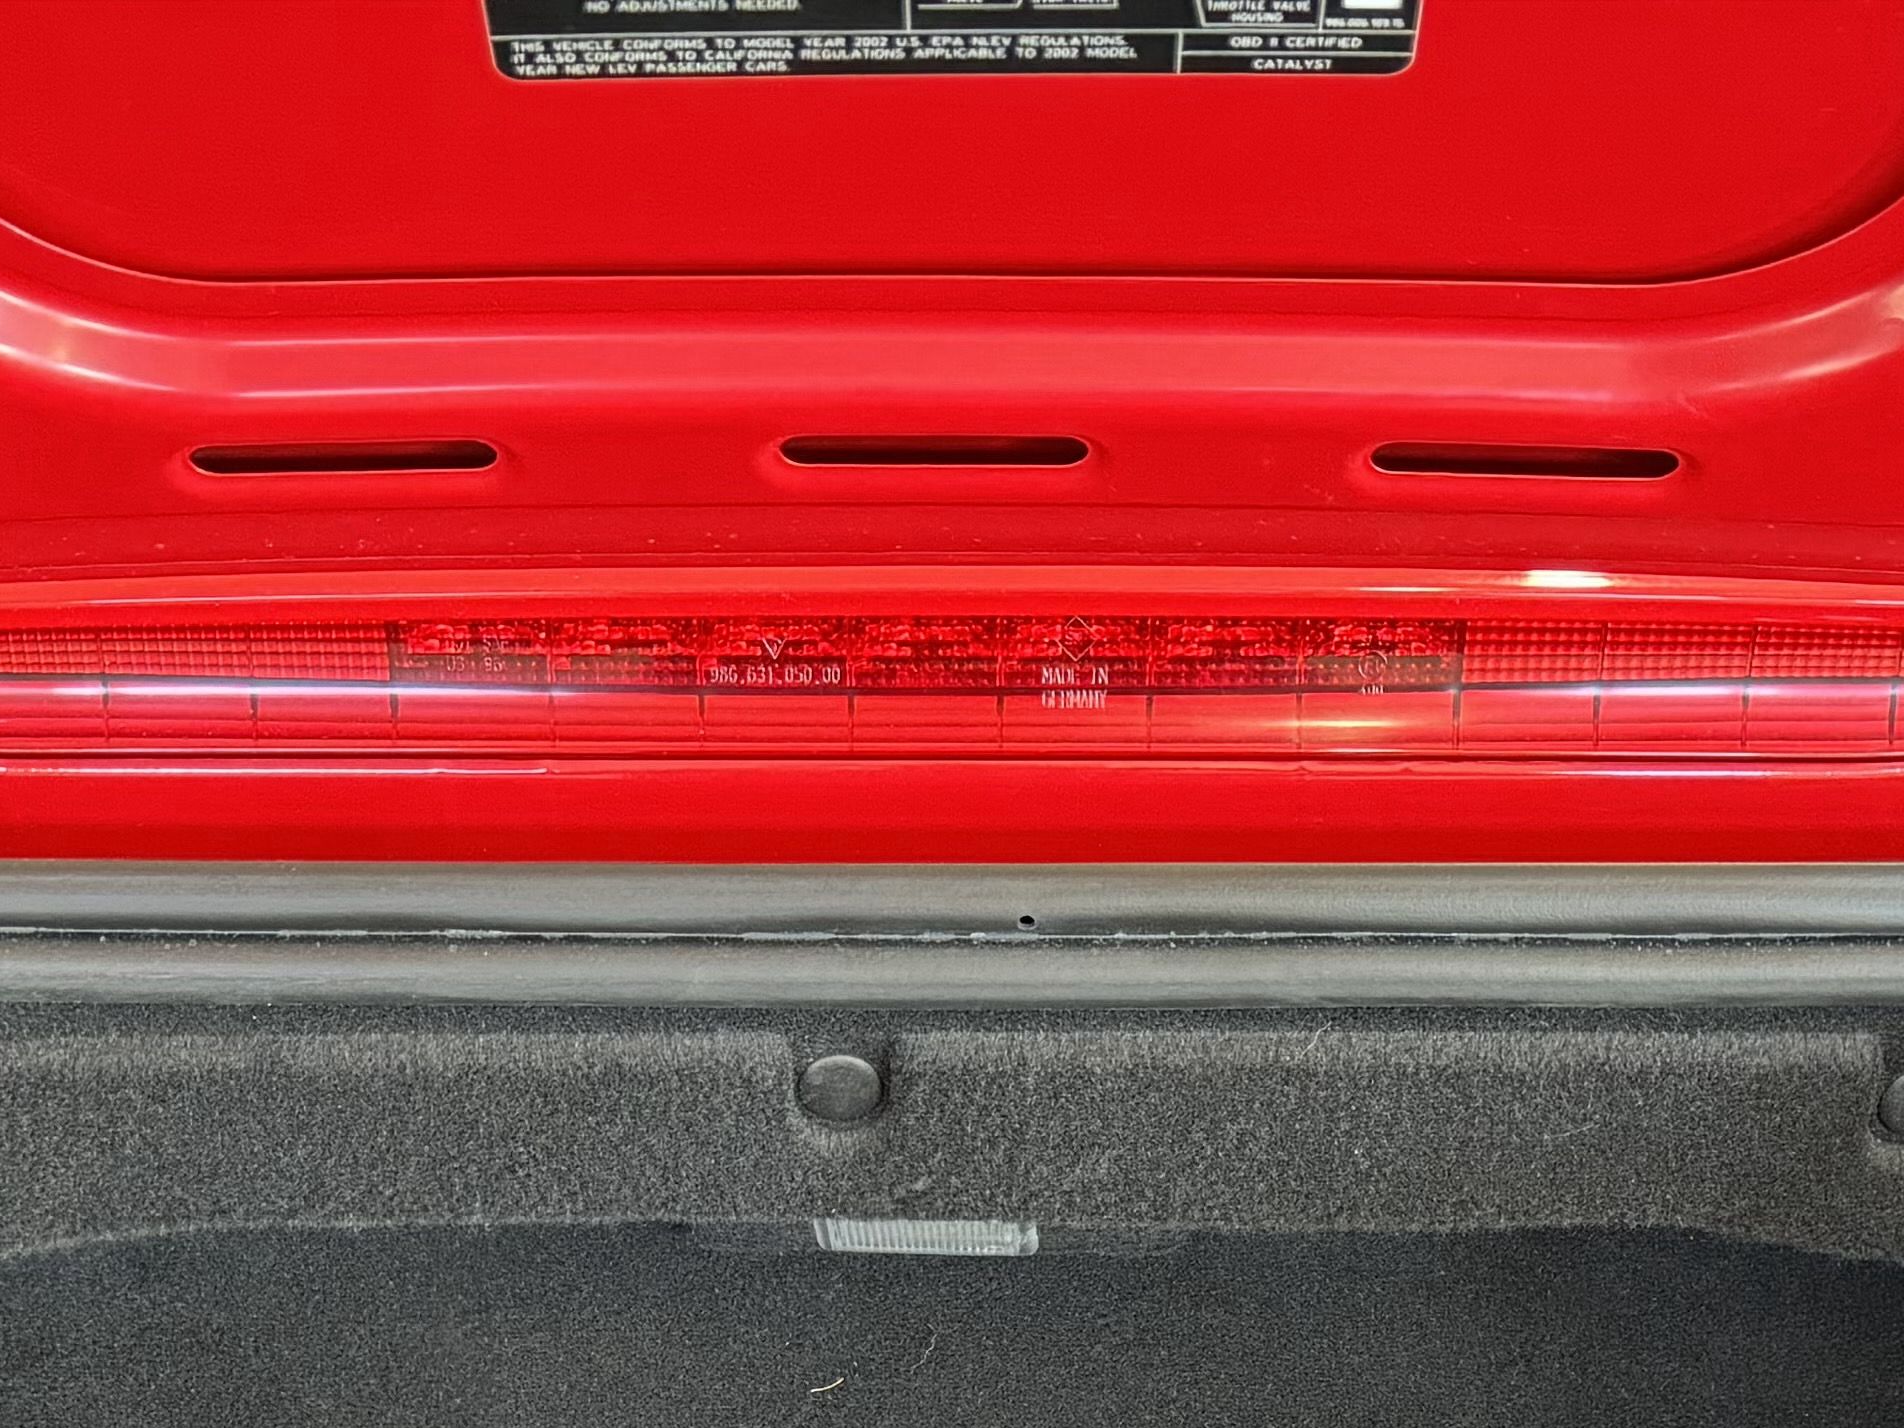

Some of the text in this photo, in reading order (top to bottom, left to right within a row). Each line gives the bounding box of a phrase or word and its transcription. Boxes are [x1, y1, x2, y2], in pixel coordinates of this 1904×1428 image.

[584, 1, 610, 13] NO
[615, 0, 729, 12] ADJUSTMENTS
[1207, 0, 1311, 12] THROTTLE VALVE
[1231, 12, 1284, 23] HOUSING
[510, 41, 545, 53] THIS
[552, 40, 615, 52] VEHICLE
[622, 39, 707, 51] CONFORMS
[715, 38, 736, 49] TO
[743, 37, 795, 49] MODEL
[803, 37, 846, 48] YEAR
[854, 36, 889, 48] 2002
[896, 36, 924, 47] U.S.
[931, 36, 965, 47] EPA
[972, 35, 1012, 47] NLEV
[1230, 36, 1264, 49] OBD
[1285, 36, 1363, 49] CERTIFIED
[510, 47, 1138, 64] IT ALSO CONFORMS TO CALIFORNIA REGULATIONS APPLICABLE TO 2002 MODEL
[515, 61, 791, 76] YEAR NEW LEV PASSENGER CARS.
[1251, 58, 1333, 71] CATALYST
[1041, 666, 1109, 685] MADE IN
